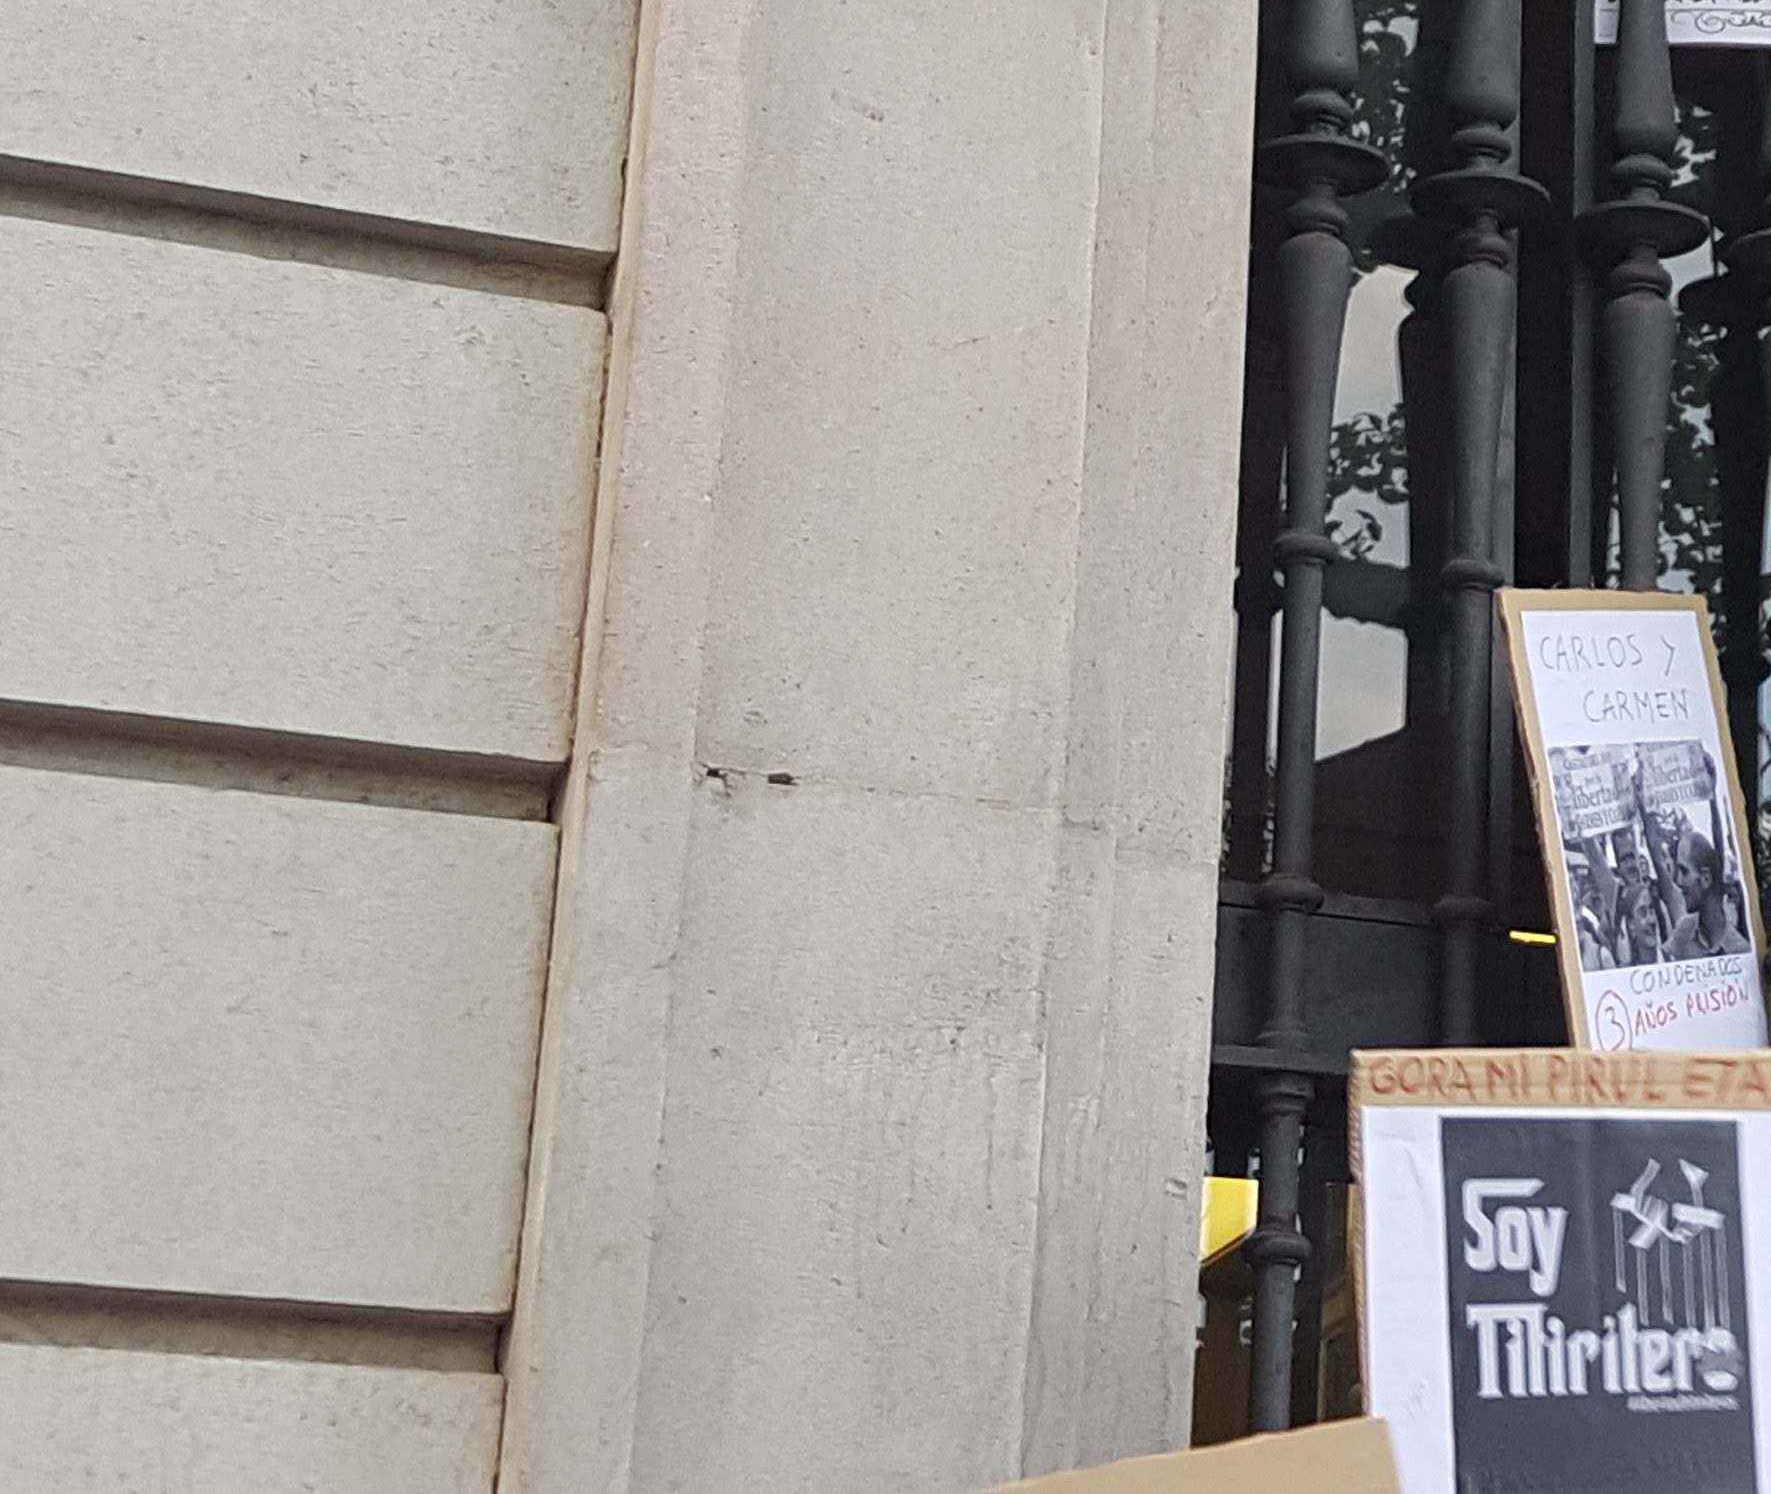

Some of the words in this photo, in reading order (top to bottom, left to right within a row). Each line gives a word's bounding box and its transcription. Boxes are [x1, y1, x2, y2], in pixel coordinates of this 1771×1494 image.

[1539, 633, 1644, 671] CARLOS
[1584, 689, 1690, 723] CARMEN
[1629, 956, 1743, 995] CONDENADOS
[1604, 1006, 1626, 1051] 3
[1635, 999, 1678, 1037] AÑOS
[1367, 1056, 1478, 1102] GORA
[1484, 1056, 1531, 1100] MI
[1462, 1178, 1569, 1297] Soy
